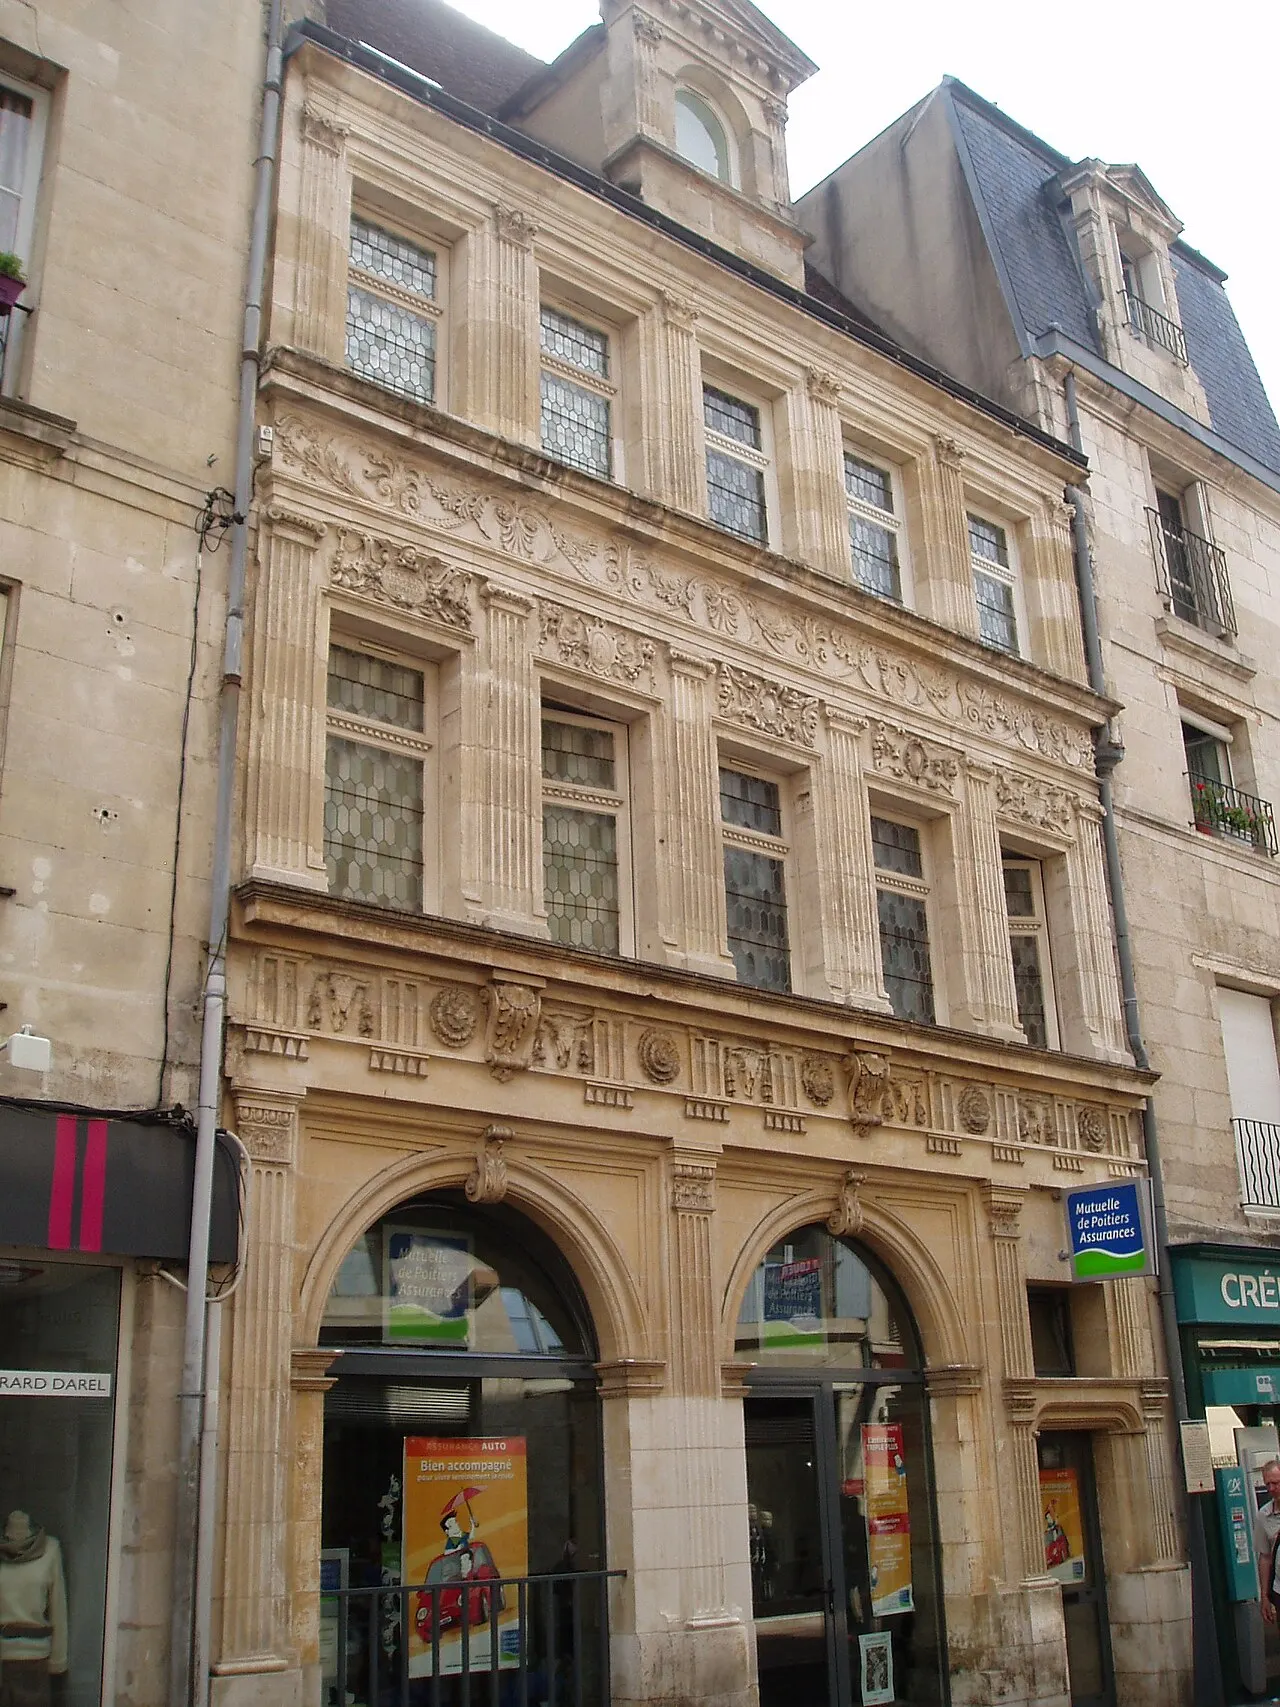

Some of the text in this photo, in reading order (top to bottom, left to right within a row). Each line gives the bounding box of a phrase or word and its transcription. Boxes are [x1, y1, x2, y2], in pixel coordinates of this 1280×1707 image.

[1075, 1198, 1120, 1215] Mutuelle
[1077, 1213, 1130, 1230] de Poitiers
[1079, 1227, 1135, 1244] Assurances
[399, 1247, 448, 1264] Mutuelle
[398, 1265, 457, 1281] de Poitiers
[398, 1283, 462, 1299] Assurances
[1220, 1269, 1280, 1308] CRÉ
[52, 1378, 106, 1392] DAREL
[481, 1442, 507, 1451] AUTO
[420, 1459, 513, 1473] Bien accompagné
